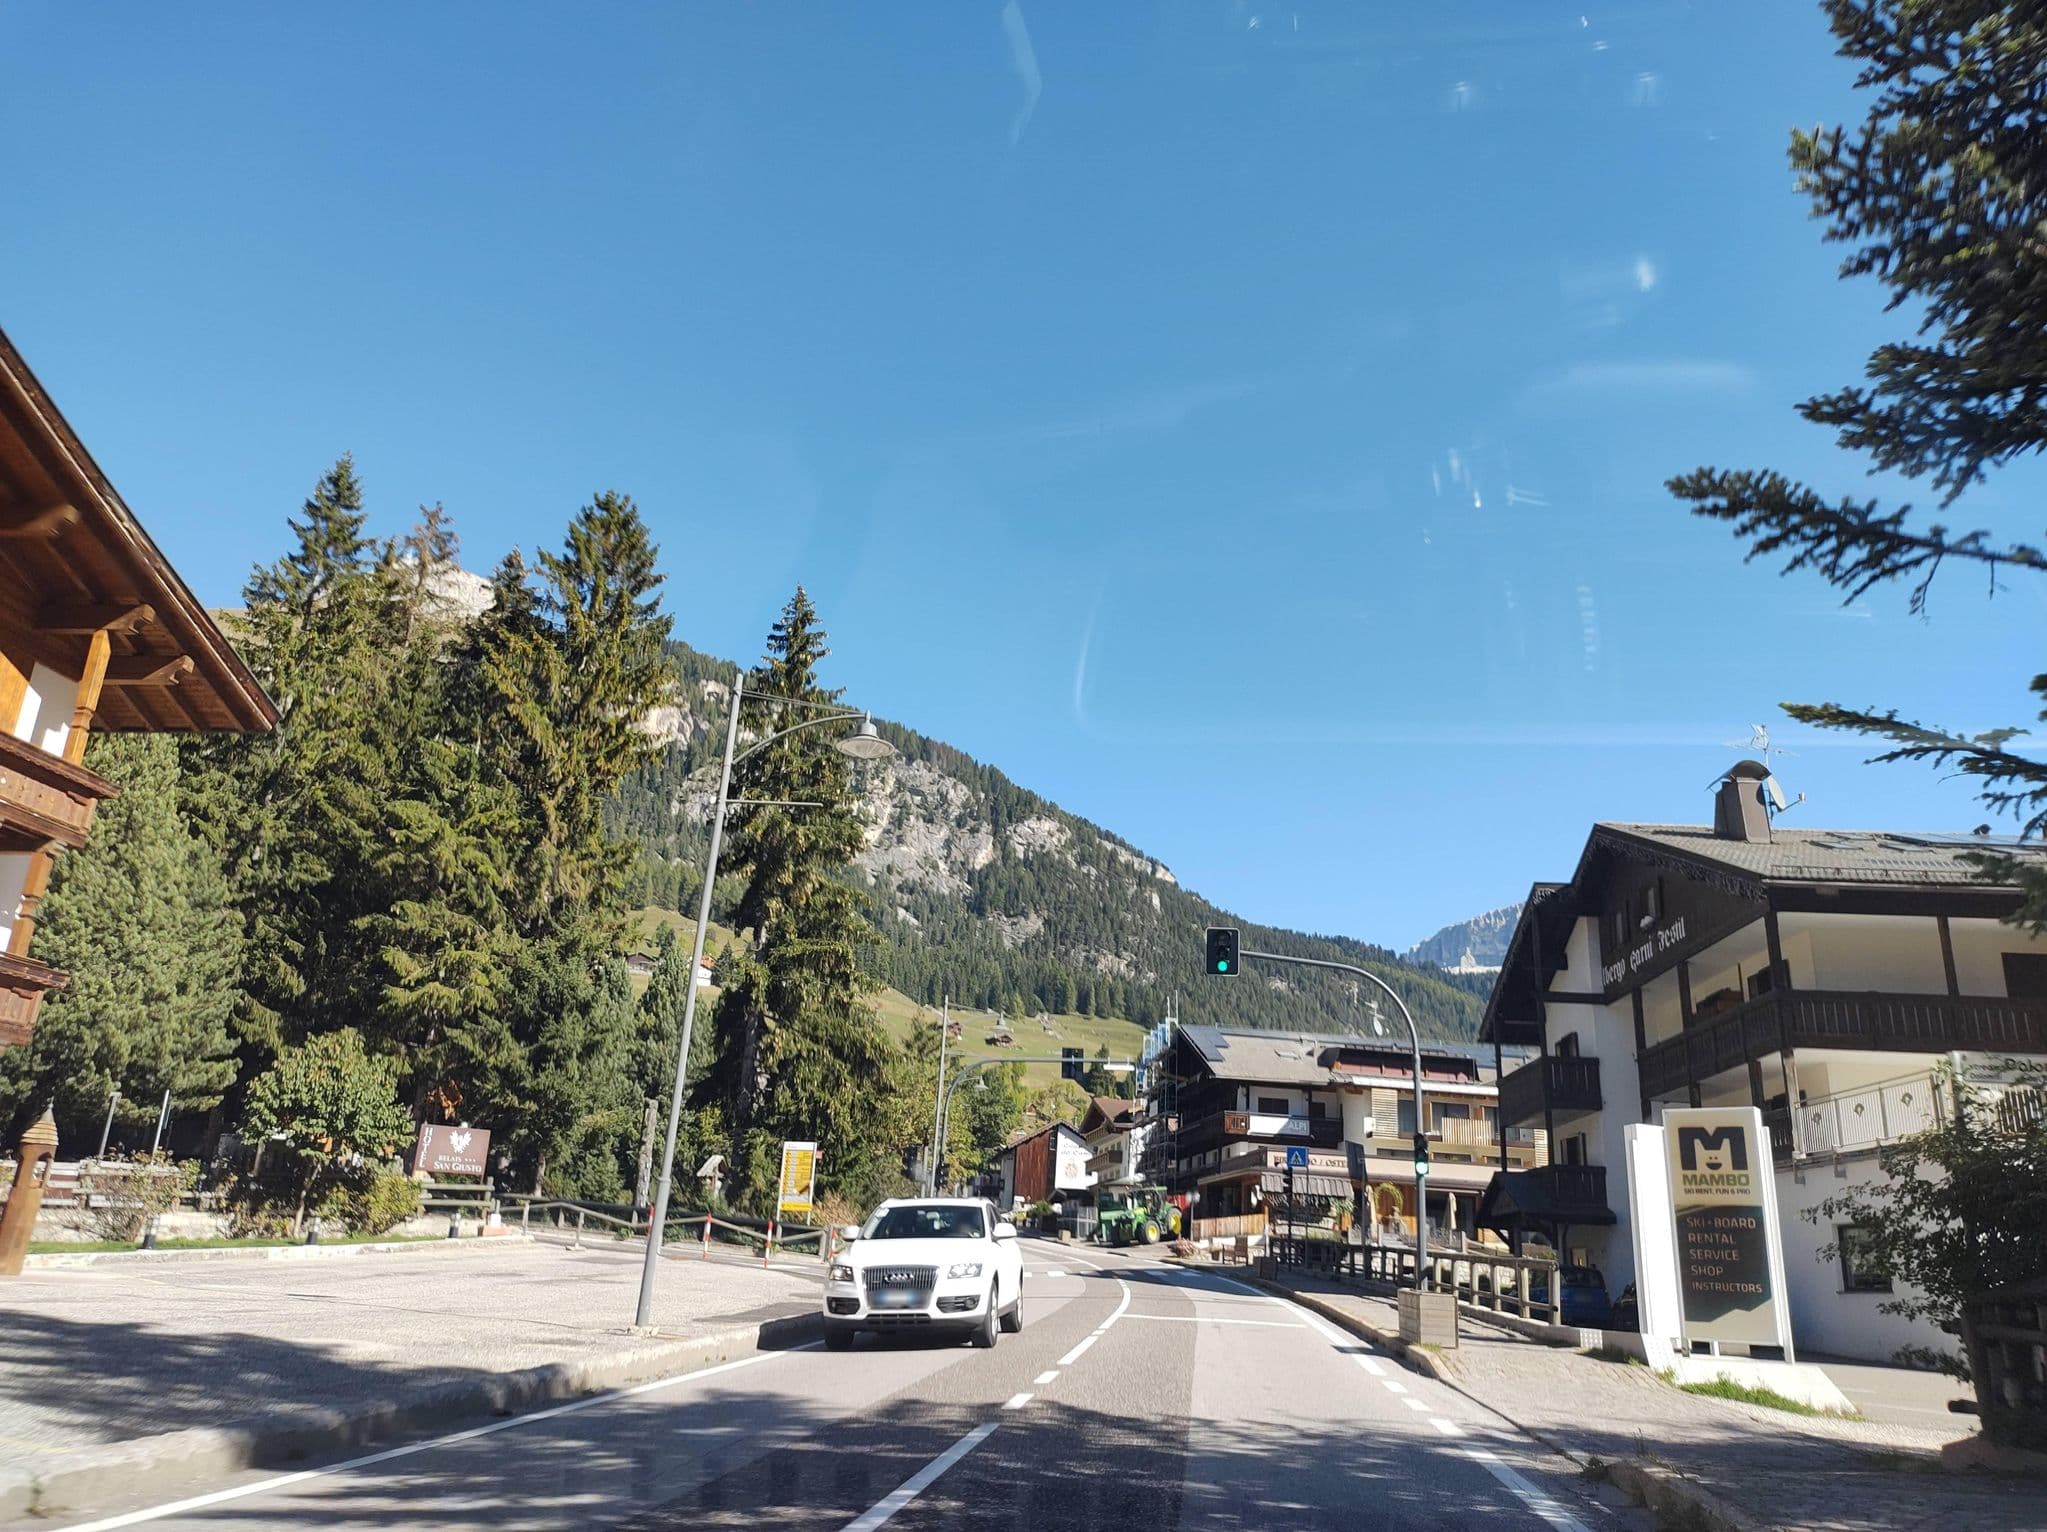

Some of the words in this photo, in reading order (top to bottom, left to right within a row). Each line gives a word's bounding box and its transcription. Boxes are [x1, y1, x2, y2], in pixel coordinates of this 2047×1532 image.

[419, 1127, 433, 1168] HOTEL
[1682, 1174, 1750, 1186] MAMBO
[1687, 1217, 1705, 1228] SKI
[1714, 1217, 1756, 1229] BOARD
[1689, 1234, 1736, 1245] RENTAL
[1690, 1250, 1740, 1261] SERVICE
[1692, 1266, 1724, 1277] SHOP
[1693, 1282, 1763, 1293] INSTRUCTORS
